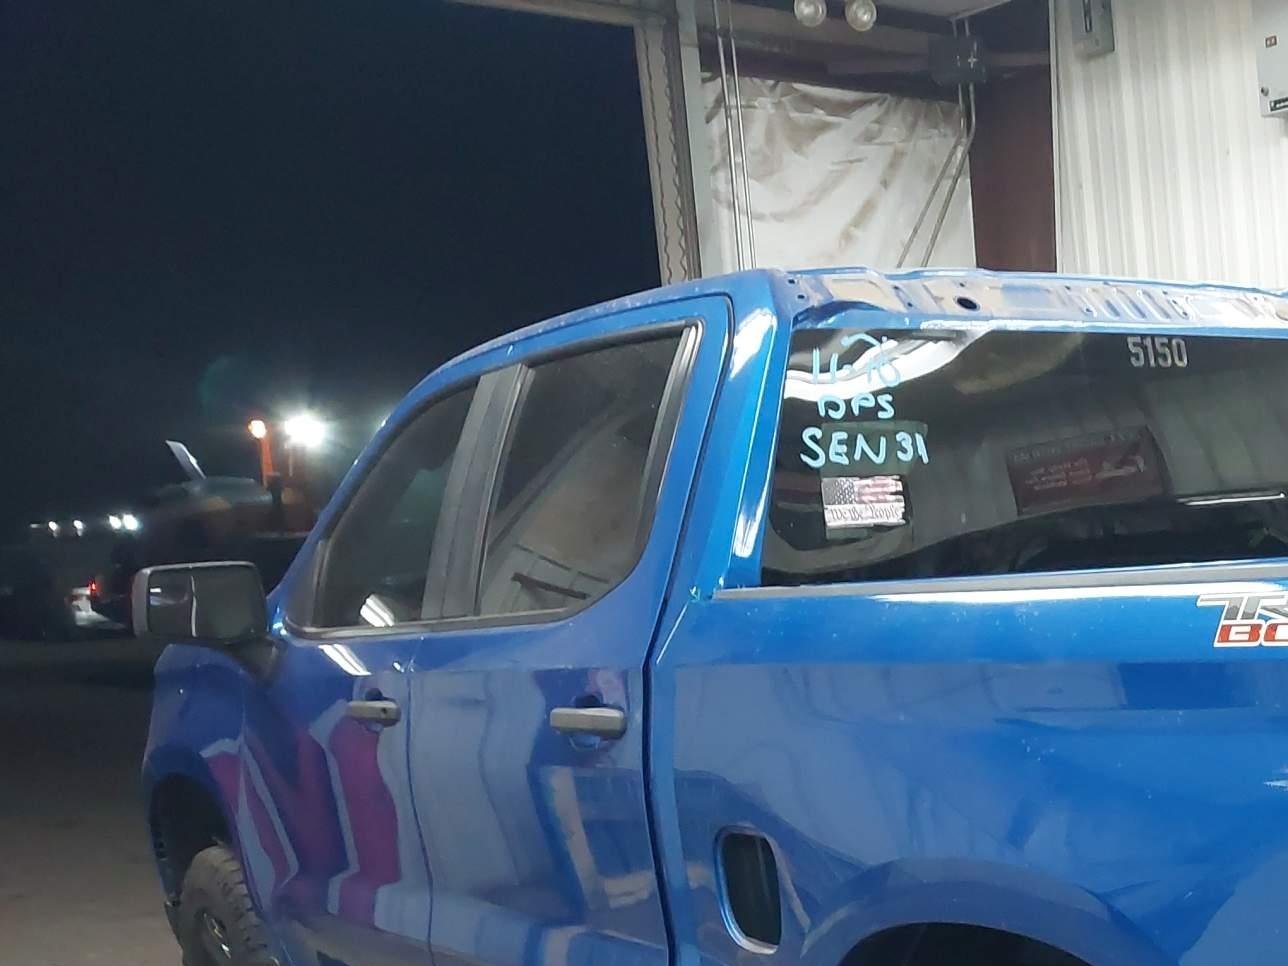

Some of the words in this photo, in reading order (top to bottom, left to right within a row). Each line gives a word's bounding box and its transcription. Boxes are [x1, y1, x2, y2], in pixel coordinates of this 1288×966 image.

[1126, 335, 1189, 368] 5150
[817, 392, 895, 420] DPS
[800, 426, 887, 468] SEN
[895, 431, 929, 465] 31
